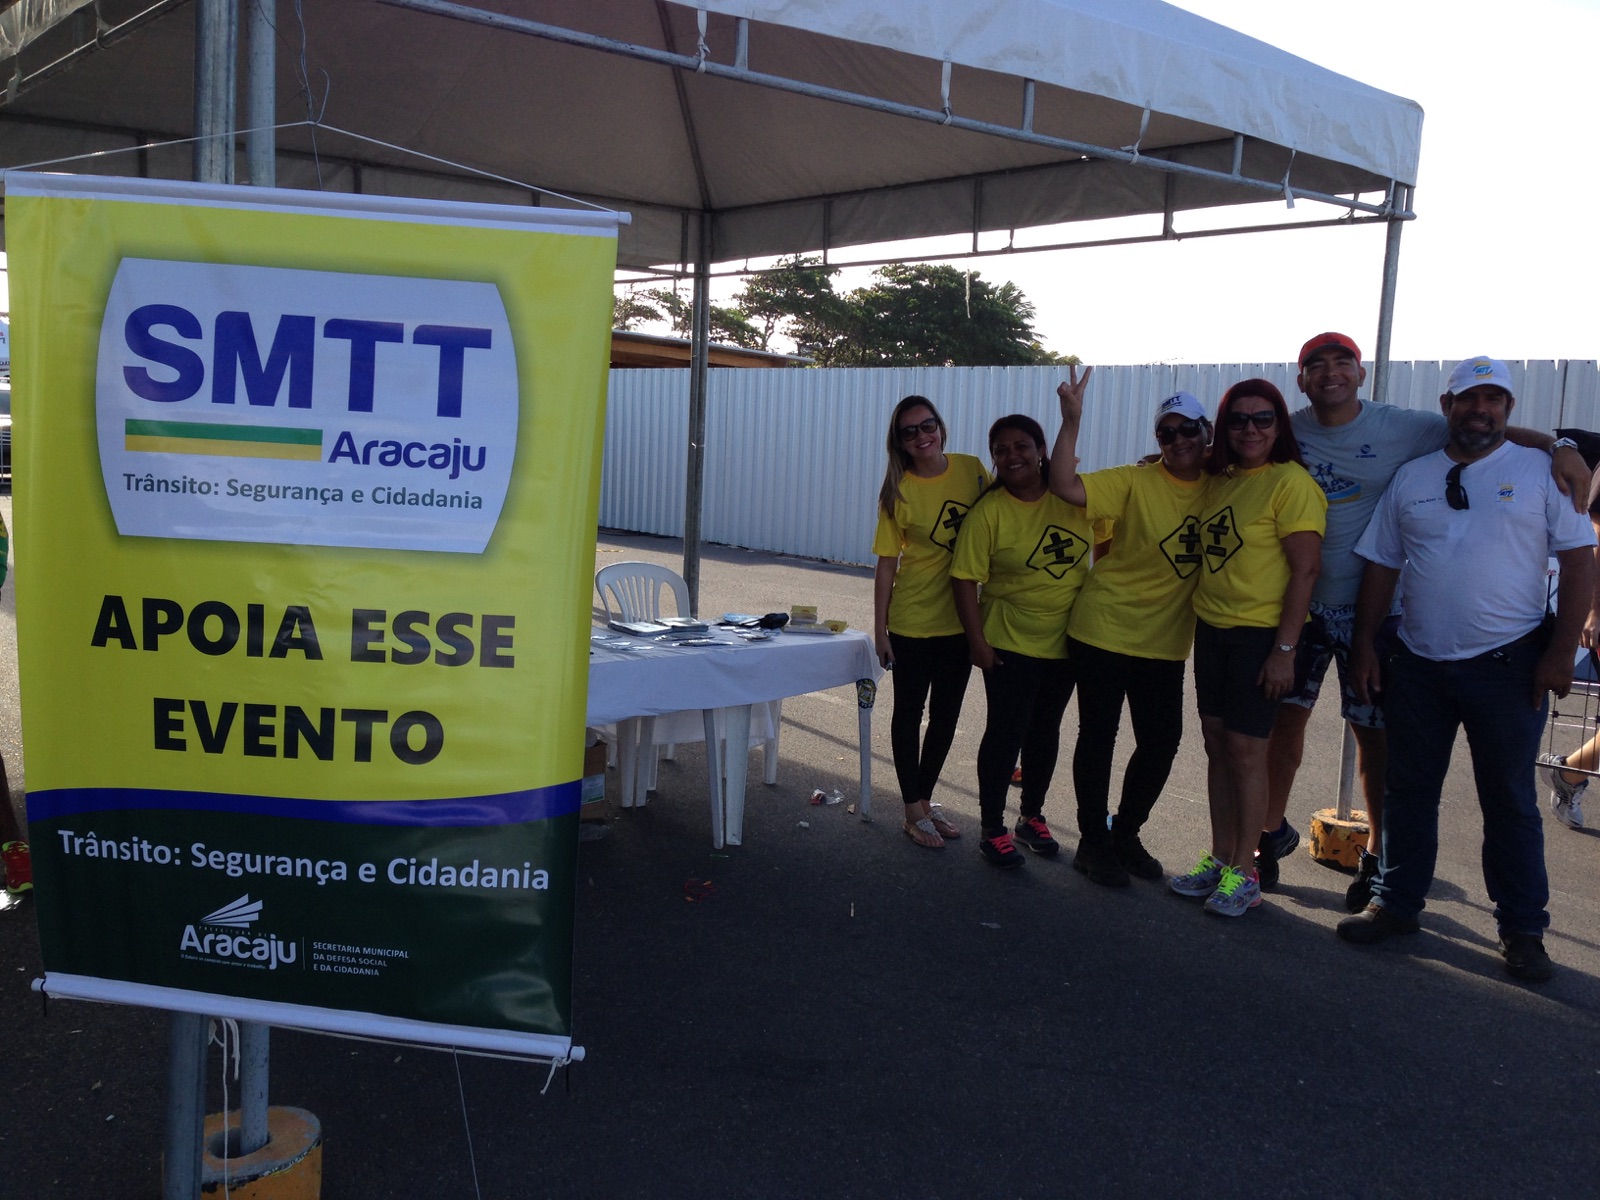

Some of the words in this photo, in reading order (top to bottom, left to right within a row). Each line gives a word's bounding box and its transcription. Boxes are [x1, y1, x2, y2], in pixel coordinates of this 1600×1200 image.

[123, 304, 492, 418] SMTT
[328, 431, 486, 480] Aracaju
[122, 473, 220, 497] Trânsito:
[226, 478, 344, 505] Segurança
[352, 487, 365, 502] e
[371, 486, 483, 510] Cidadania
[91, 594, 323, 661] APOIA
[350, 609, 516, 669] ESSE
[153, 697, 444, 765] EVENTO
[58, 829, 182, 866] Trânsito:
[190, 843, 348, 885] Segurança
[359, 863, 377, 884] e
[387, 858, 550, 890] Cidadania
[180, 924, 296, 970] Aracaju
[313, 941, 361, 954] SECRETARIA
[362, 947, 410, 959] MUNICIPAL
[313, 952, 326, 961] DA
[327, 954, 357, 964] DEFESA
[358, 957, 388, 967] SOCIAL
[313, 963, 319, 971] E
[320, 964, 332, 972] DA
[333, 965, 380, 976] CIDADANIA
